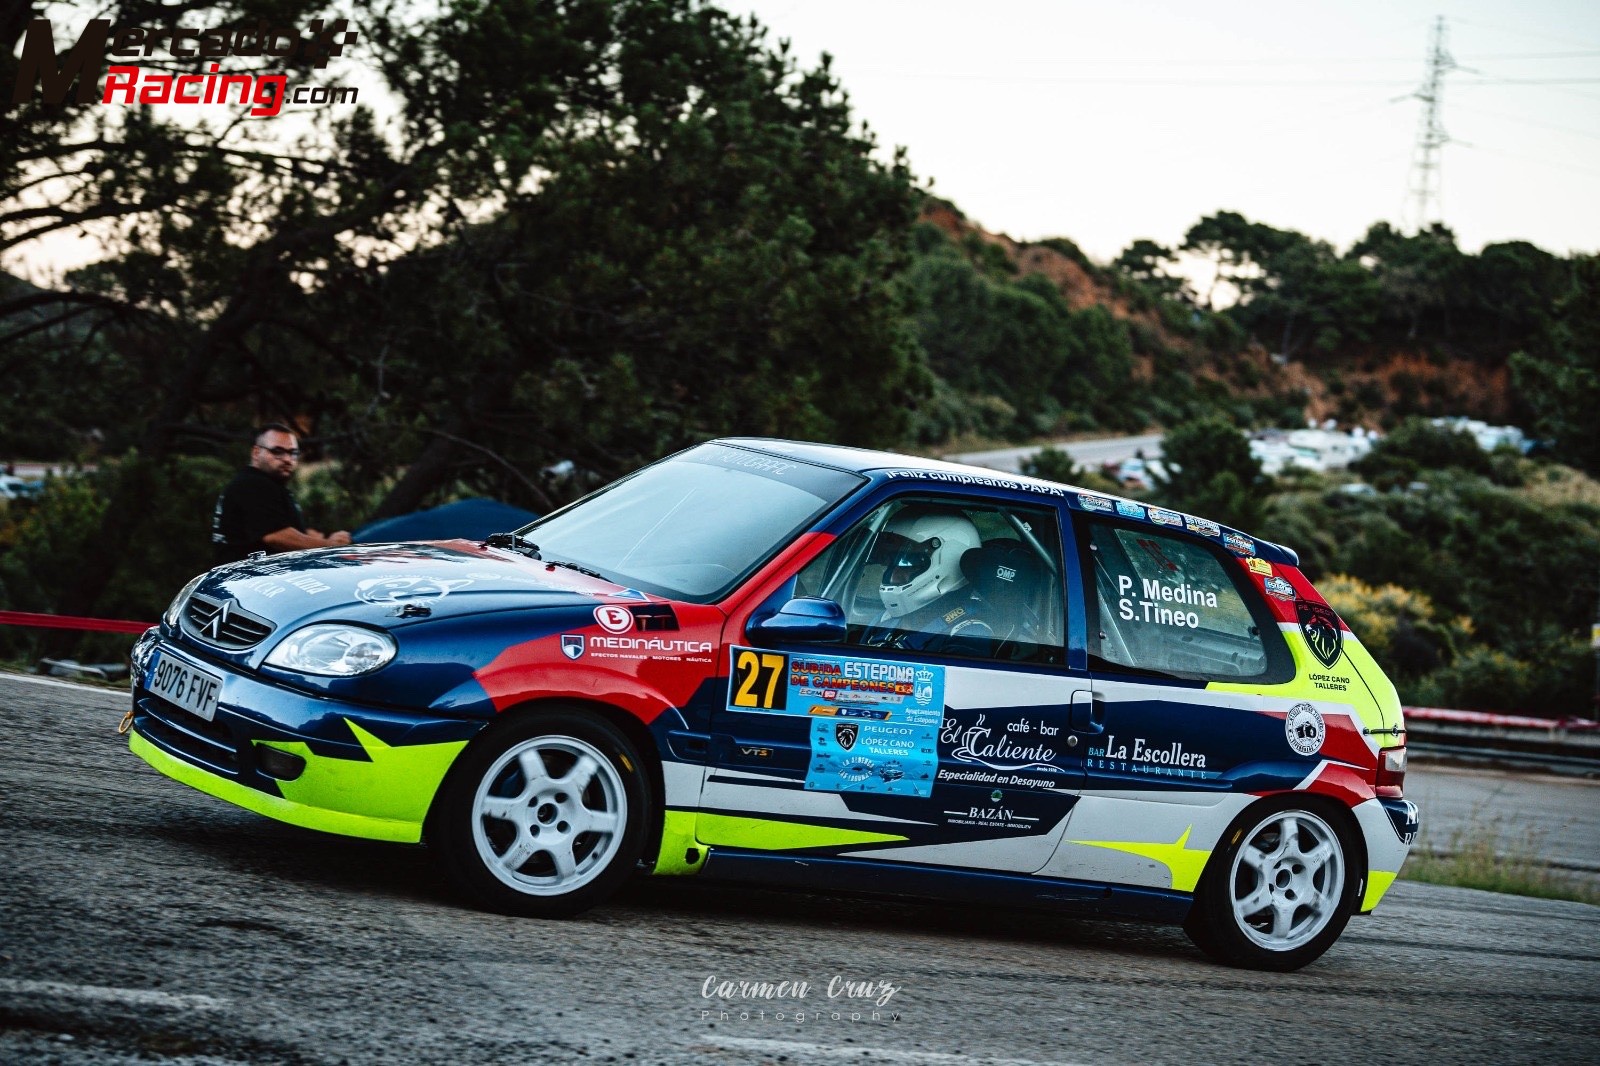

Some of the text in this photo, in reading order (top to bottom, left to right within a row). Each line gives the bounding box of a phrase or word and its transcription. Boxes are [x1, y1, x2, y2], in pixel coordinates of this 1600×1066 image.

[996, 567, 1016, 580] OMP
[1118, 575, 1218, 608] P. Medina
[1119, 598, 1199, 629] S.Tineo
[734, 650, 785, 709] 27
[844, 661, 915, 683] ESTEPONA
[1332, 675, 1350, 683] CANO
[154, 659, 217, 711] 9076 FVF
[791, 675, 809, 687] DE
[812, 676, 896, 694] CAMPEONES
[1315, 682, 1347, 691] TALLERES
[864, 725, 914, 735] PEUGEOT
[1007, 718, 1030, 733] café
[1040, 720, 1059, 736] bar
[741, 747, 768, 756] VTS
[861, 736, 915, 748] LÓPEZ CANO
[868, 747, 909, 756] TALLERES
[967, 727, 1057, 762] Caliente
[1088, 735, 1206, 768] BAR La Escollera
[1087, 758, 1207, 780] RESTAURANTE
[938, 769, 1055, 789] Especialidad en Desayuno
[968, 806, 1014, 821] BAZÁN
